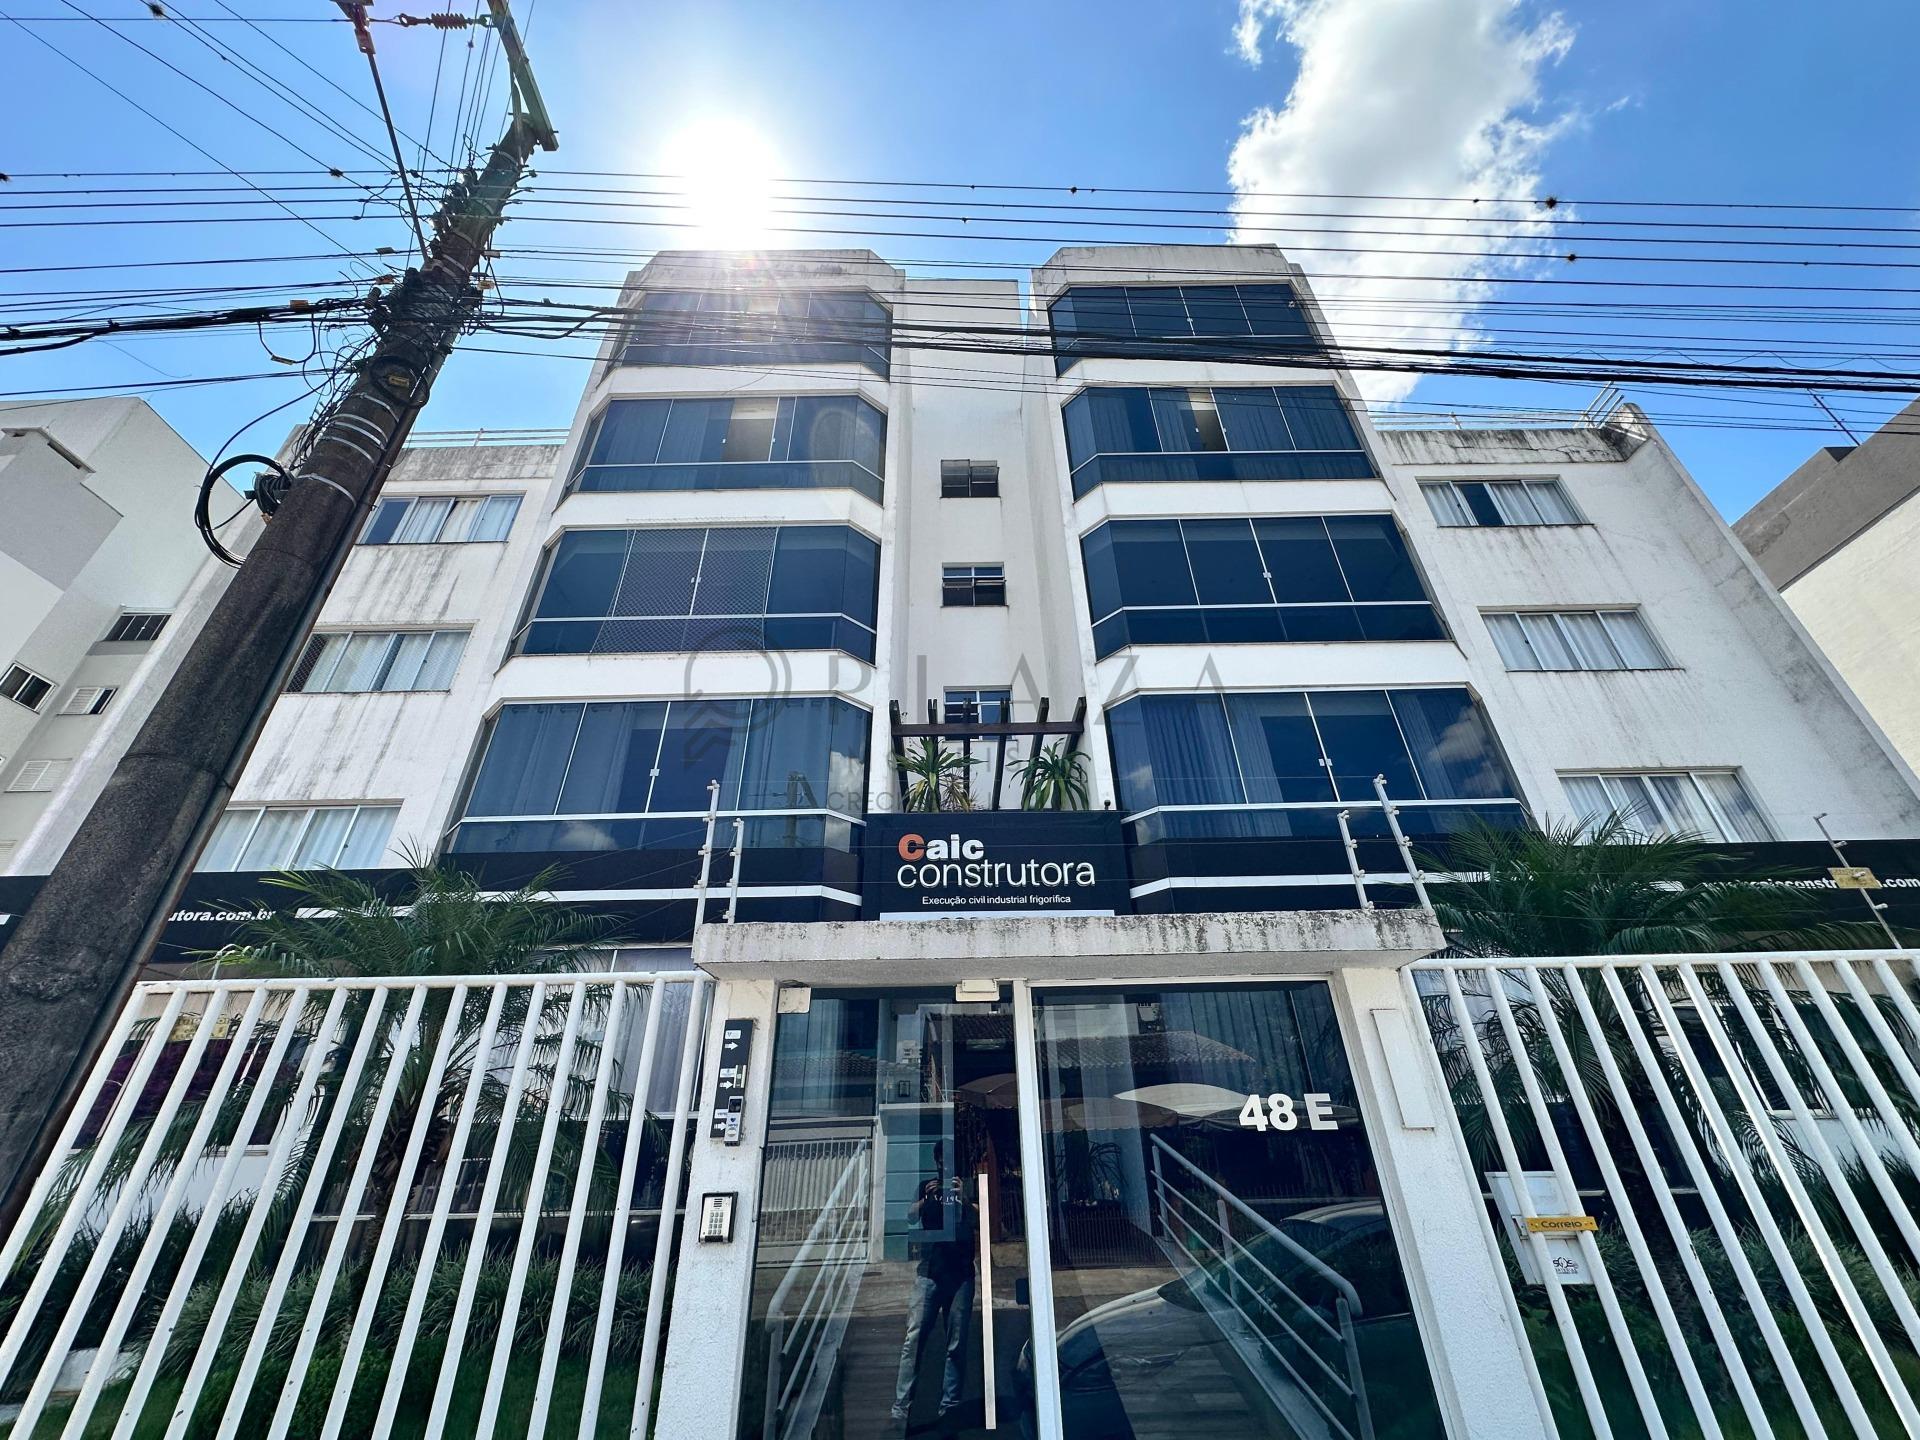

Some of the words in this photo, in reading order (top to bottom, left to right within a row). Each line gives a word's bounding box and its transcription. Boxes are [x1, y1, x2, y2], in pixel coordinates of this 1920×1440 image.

[898, 833, 984, 861] Caic
[897, 859, 1096, 888] construtora
[921, 895, 966, 907] Execução
[968, 894, 986, 905] civil
[986, 894, 1027, 905] industrial
[1238, 1093, 1298, 1132] 48
[1303, 1093, 1339, 1131] E
[1541, 1220, 1582, 1229] Correio
